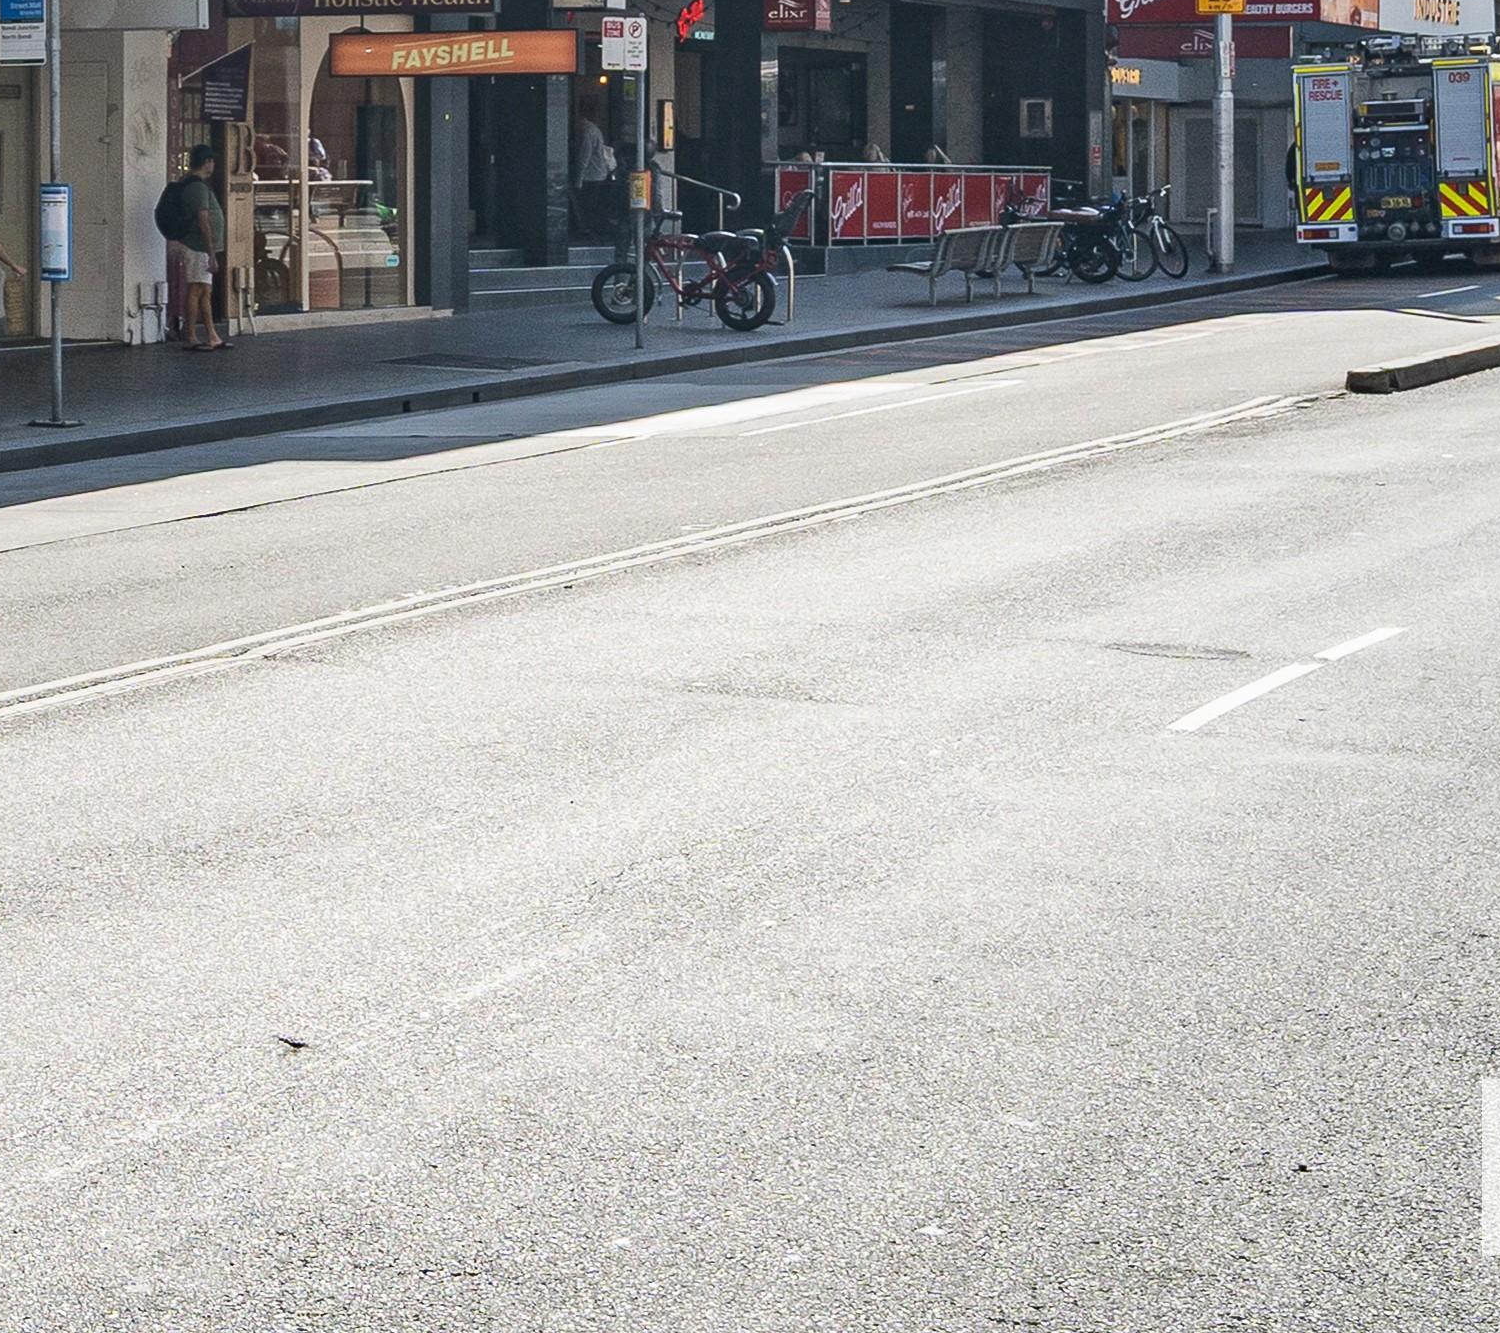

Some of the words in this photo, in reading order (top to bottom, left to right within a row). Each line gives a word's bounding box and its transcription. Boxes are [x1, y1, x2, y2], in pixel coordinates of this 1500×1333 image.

[768, 4, 807, 19] elixr
[1180, 36, 1213, 52] elix
[391, 38, 515, 71] FAYSHELL
[1311, 78, 1331, 89] FIRE
[1448, 71, 1471, 83] 039
[1308, 89, 1343, 101] RESCUE
